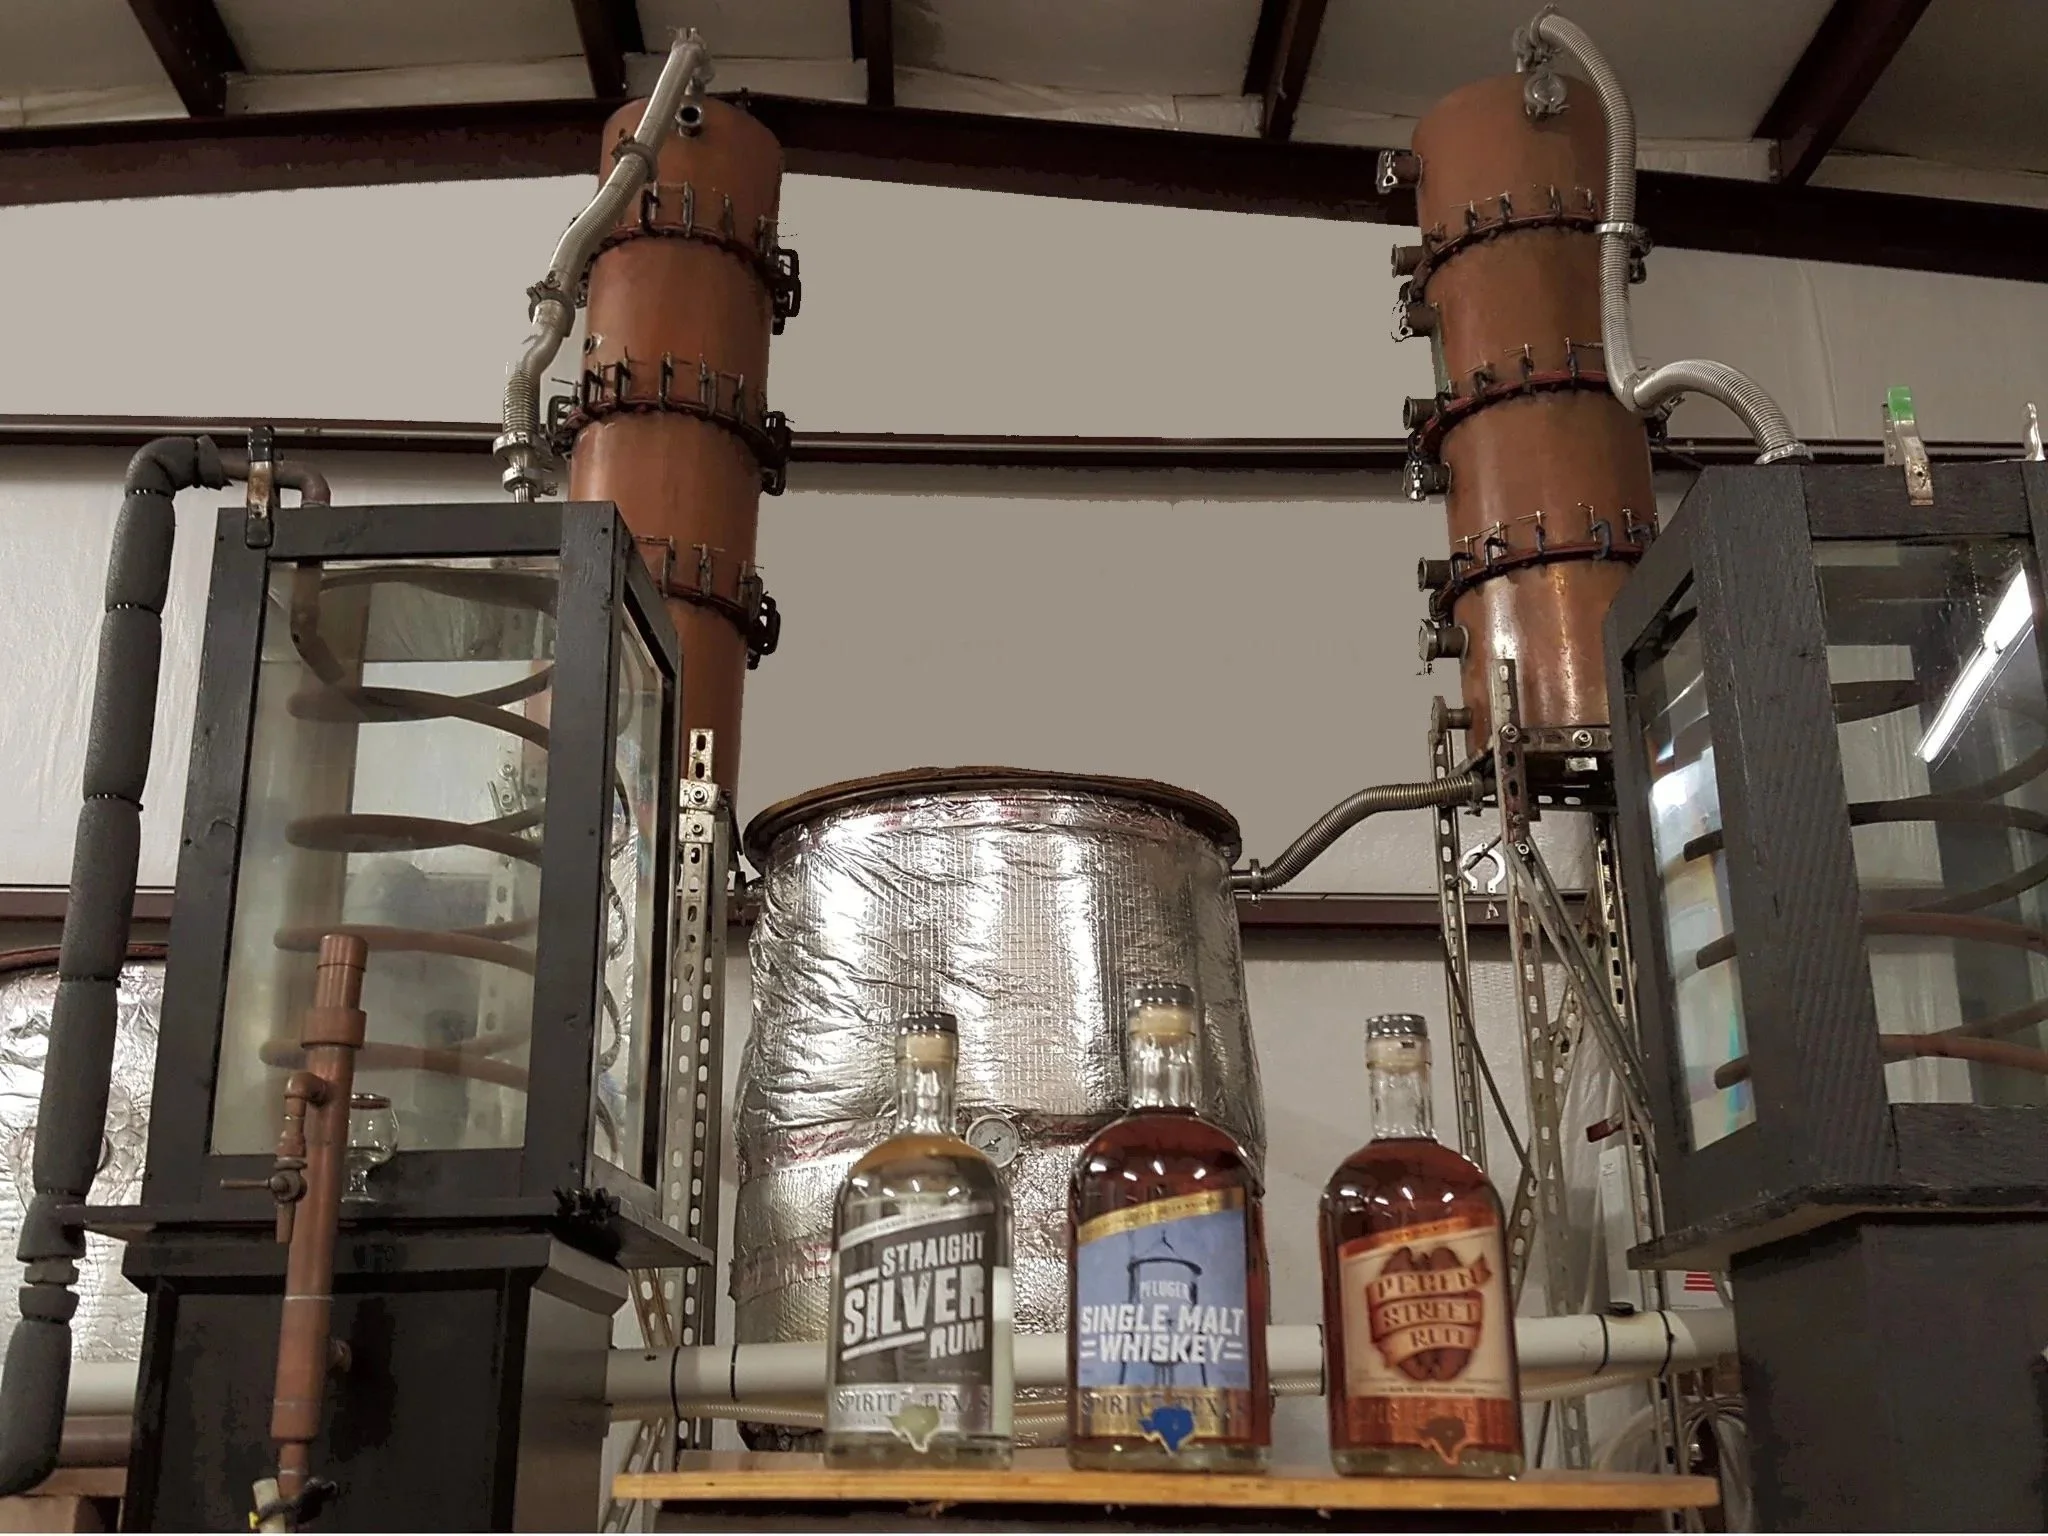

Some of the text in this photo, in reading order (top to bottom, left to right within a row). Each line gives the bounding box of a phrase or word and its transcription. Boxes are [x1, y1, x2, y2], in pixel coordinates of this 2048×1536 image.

[881, 1231, 985, 1278] STRAIGHT
[843, 1264, 985, 1346] SILVER
[1081, 1303, 1244, 1336] SINGLE MALT
[1383, 1302, 1478, 1327] STREET
[930, 1320, 985, 1359] RUM
[1100, 1333, 1225, 1364] WHISKEY
